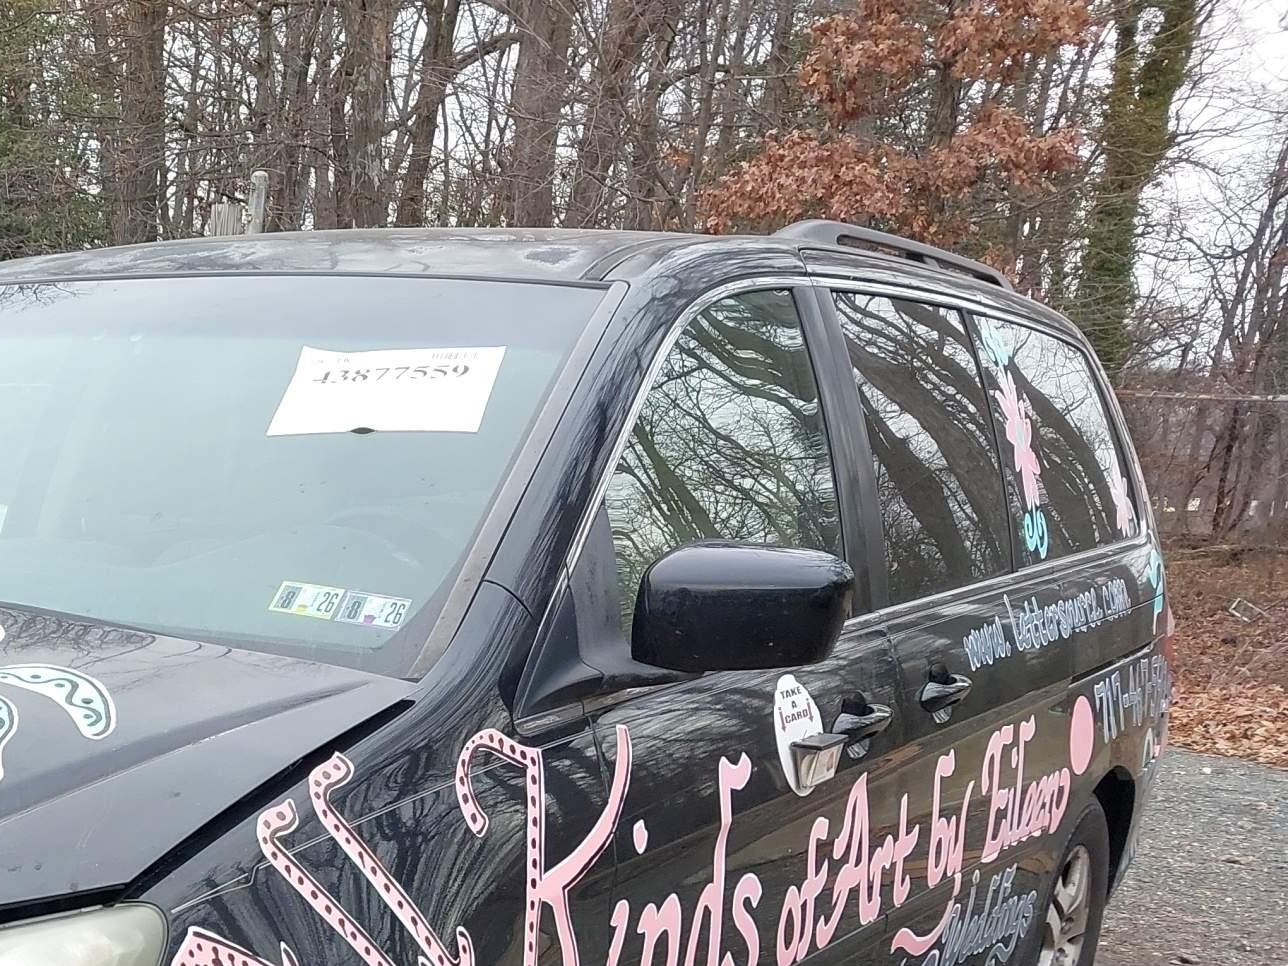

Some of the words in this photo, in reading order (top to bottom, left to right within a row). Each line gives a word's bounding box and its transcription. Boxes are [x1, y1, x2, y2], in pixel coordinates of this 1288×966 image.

[316, 591, 339, 614] 26
[383, 602, 406, 625] 26
[779, 685, 803, 700] TAKE
[791, 700, 798, 710] A
[784, 708, 809, 724] CARD
[815, 771, 920, 950] Art
[890, 748, 975, 957] by
[981, 714, 1071, 864] Eileen
